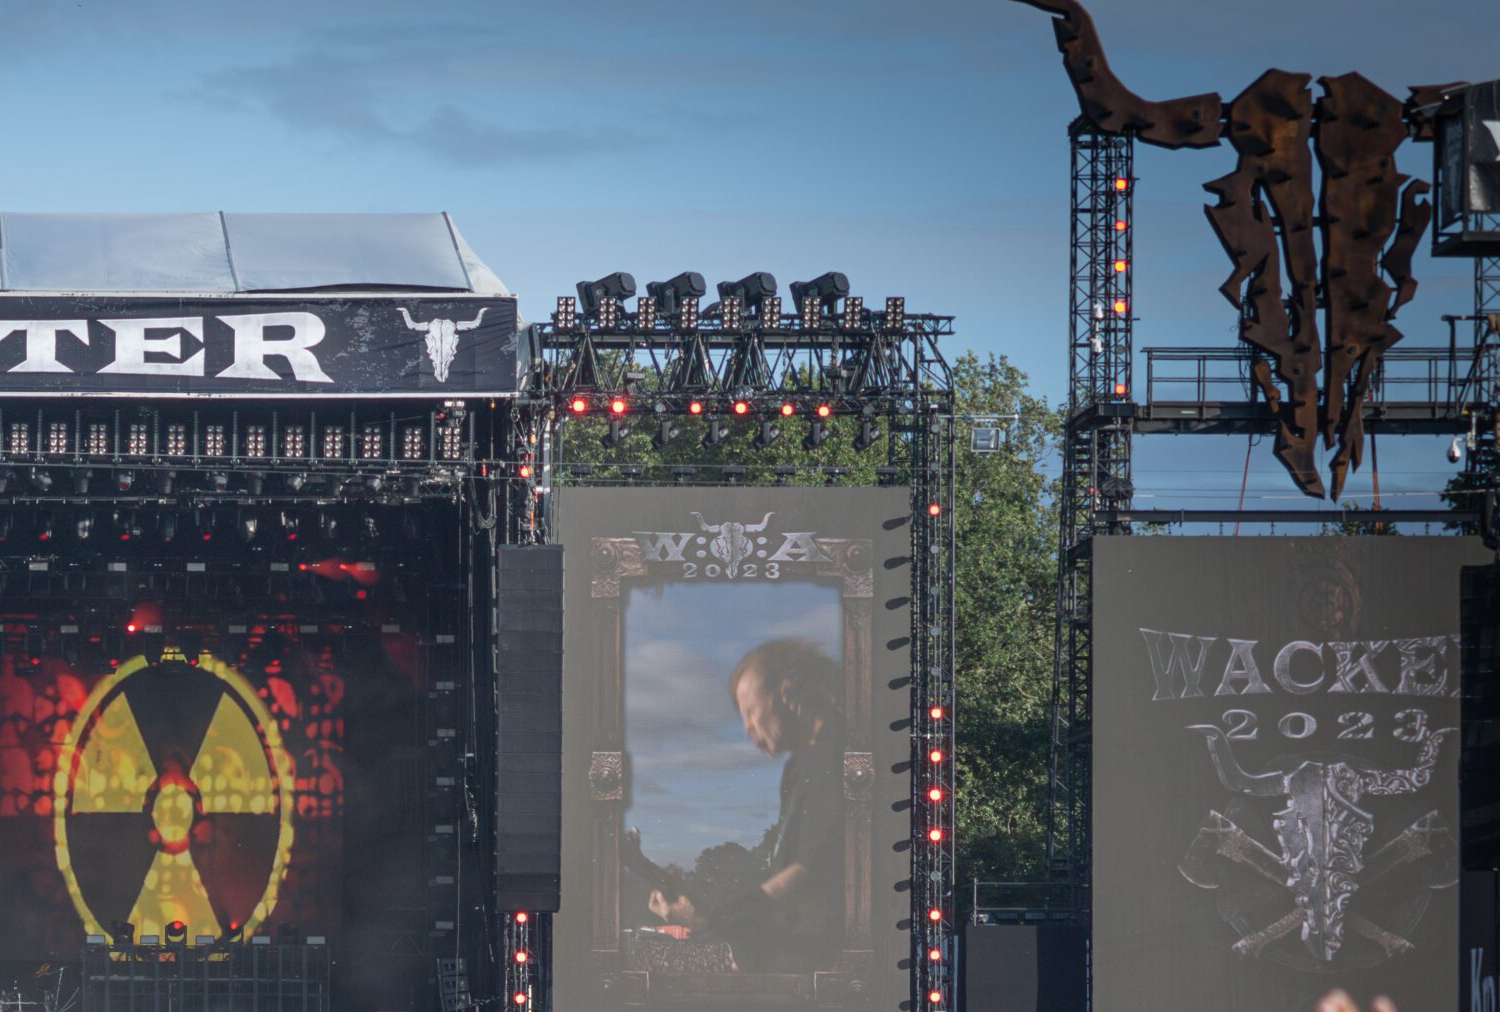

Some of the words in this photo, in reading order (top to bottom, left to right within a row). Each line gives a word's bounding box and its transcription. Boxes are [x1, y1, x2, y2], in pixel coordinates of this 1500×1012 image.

[682, 562, 781, 580] 2023
[1139, 627, 1461, 701] WACKE
[1222, 709, 1429, 743] 2023
